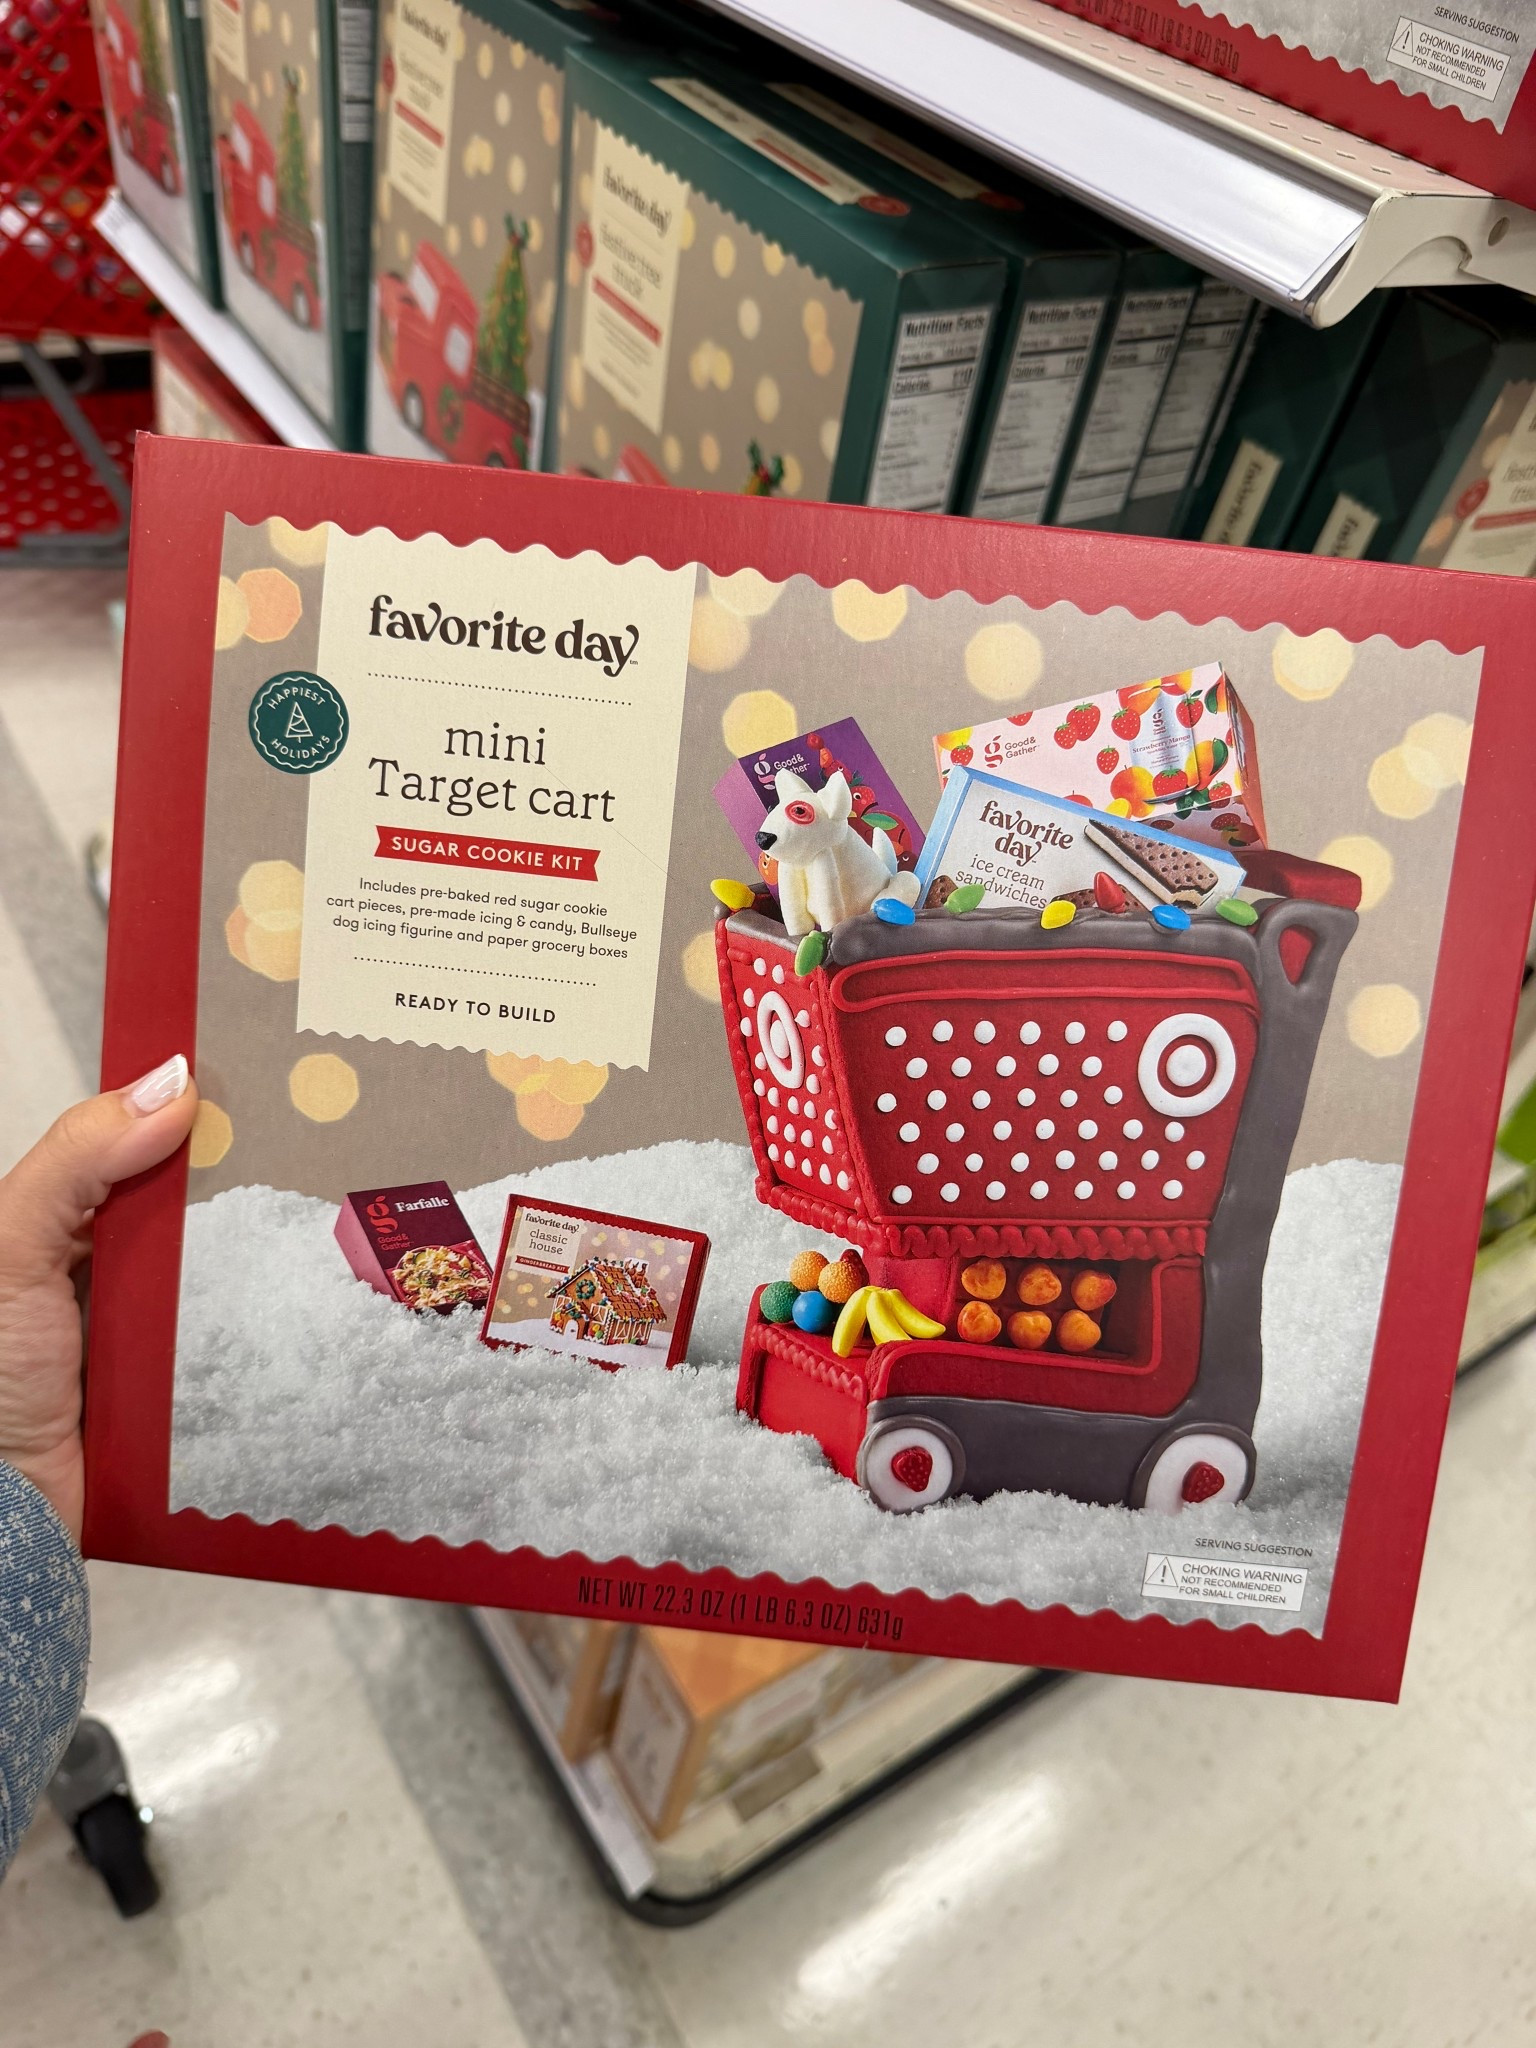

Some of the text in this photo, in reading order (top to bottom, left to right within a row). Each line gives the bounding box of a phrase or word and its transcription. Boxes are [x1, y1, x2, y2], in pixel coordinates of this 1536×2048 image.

[1434, 6, 1519, 43] SERVING SUGGESTION
[1416, 45, 1486, 77] NOT RECOMMENDED
[1419, 32, 1504, 71] CHOKING WARNING
[1412, 55, 1487, 90] FOR SMALL CHILDREN
[369, 594, 546, 655] favorite
[555, 619, 640, 677] day
[267, 687, 326, 710] HAPPIEST
[271, 735, 330, 759] HOLIDAYS
[444, 722, 547, 765] mini
[1005, 746, 1037, 759] Gather
[1132, 740, 1168, 754] Strawberry
[1168, 734, 1191, 745] Mango
[368, 757, 617, 823] Target cart
[979, 800, 1074, 849] favorite
[391, 836, 583, 871] SUGAR COOKIE KIT
[994, 832, 1043, 867] day
[955, 870, 1048, 909] sandwiches
[970, 853, 1045, 891] ice cream
[359, 877, 608, 917] Includes pre-baked red sugar cookie
[326, 896, 637, 941] cart pieces, pre-made icing & candy, Bullseye
[333, 915, 628, 959] dog icing figurine and paper grocery boxes
[395, 992, 556, 1023] READY TO BUILD
[395, 1196, 450, 1213] Farfalle
[525, 1213, 579, 1234] favorite day
[529, 1228, 568, 1245] classic
[528, 1238, 563, 1255] house
[1195, 1537, 1313, 1558] SERVING SUGGESTION
[1181, 1575, 1282, 1593] NOT RECOMMENDED
[1182, 1563, 1303, 1584] CHOKING WARNING
[578, 1575, 904, 1641] NET WT 22.3 OZ (1 LB 6.3 OZ) 631g
[1179, 1586, 1286, 1604] FOR SMALL CHILDREN
